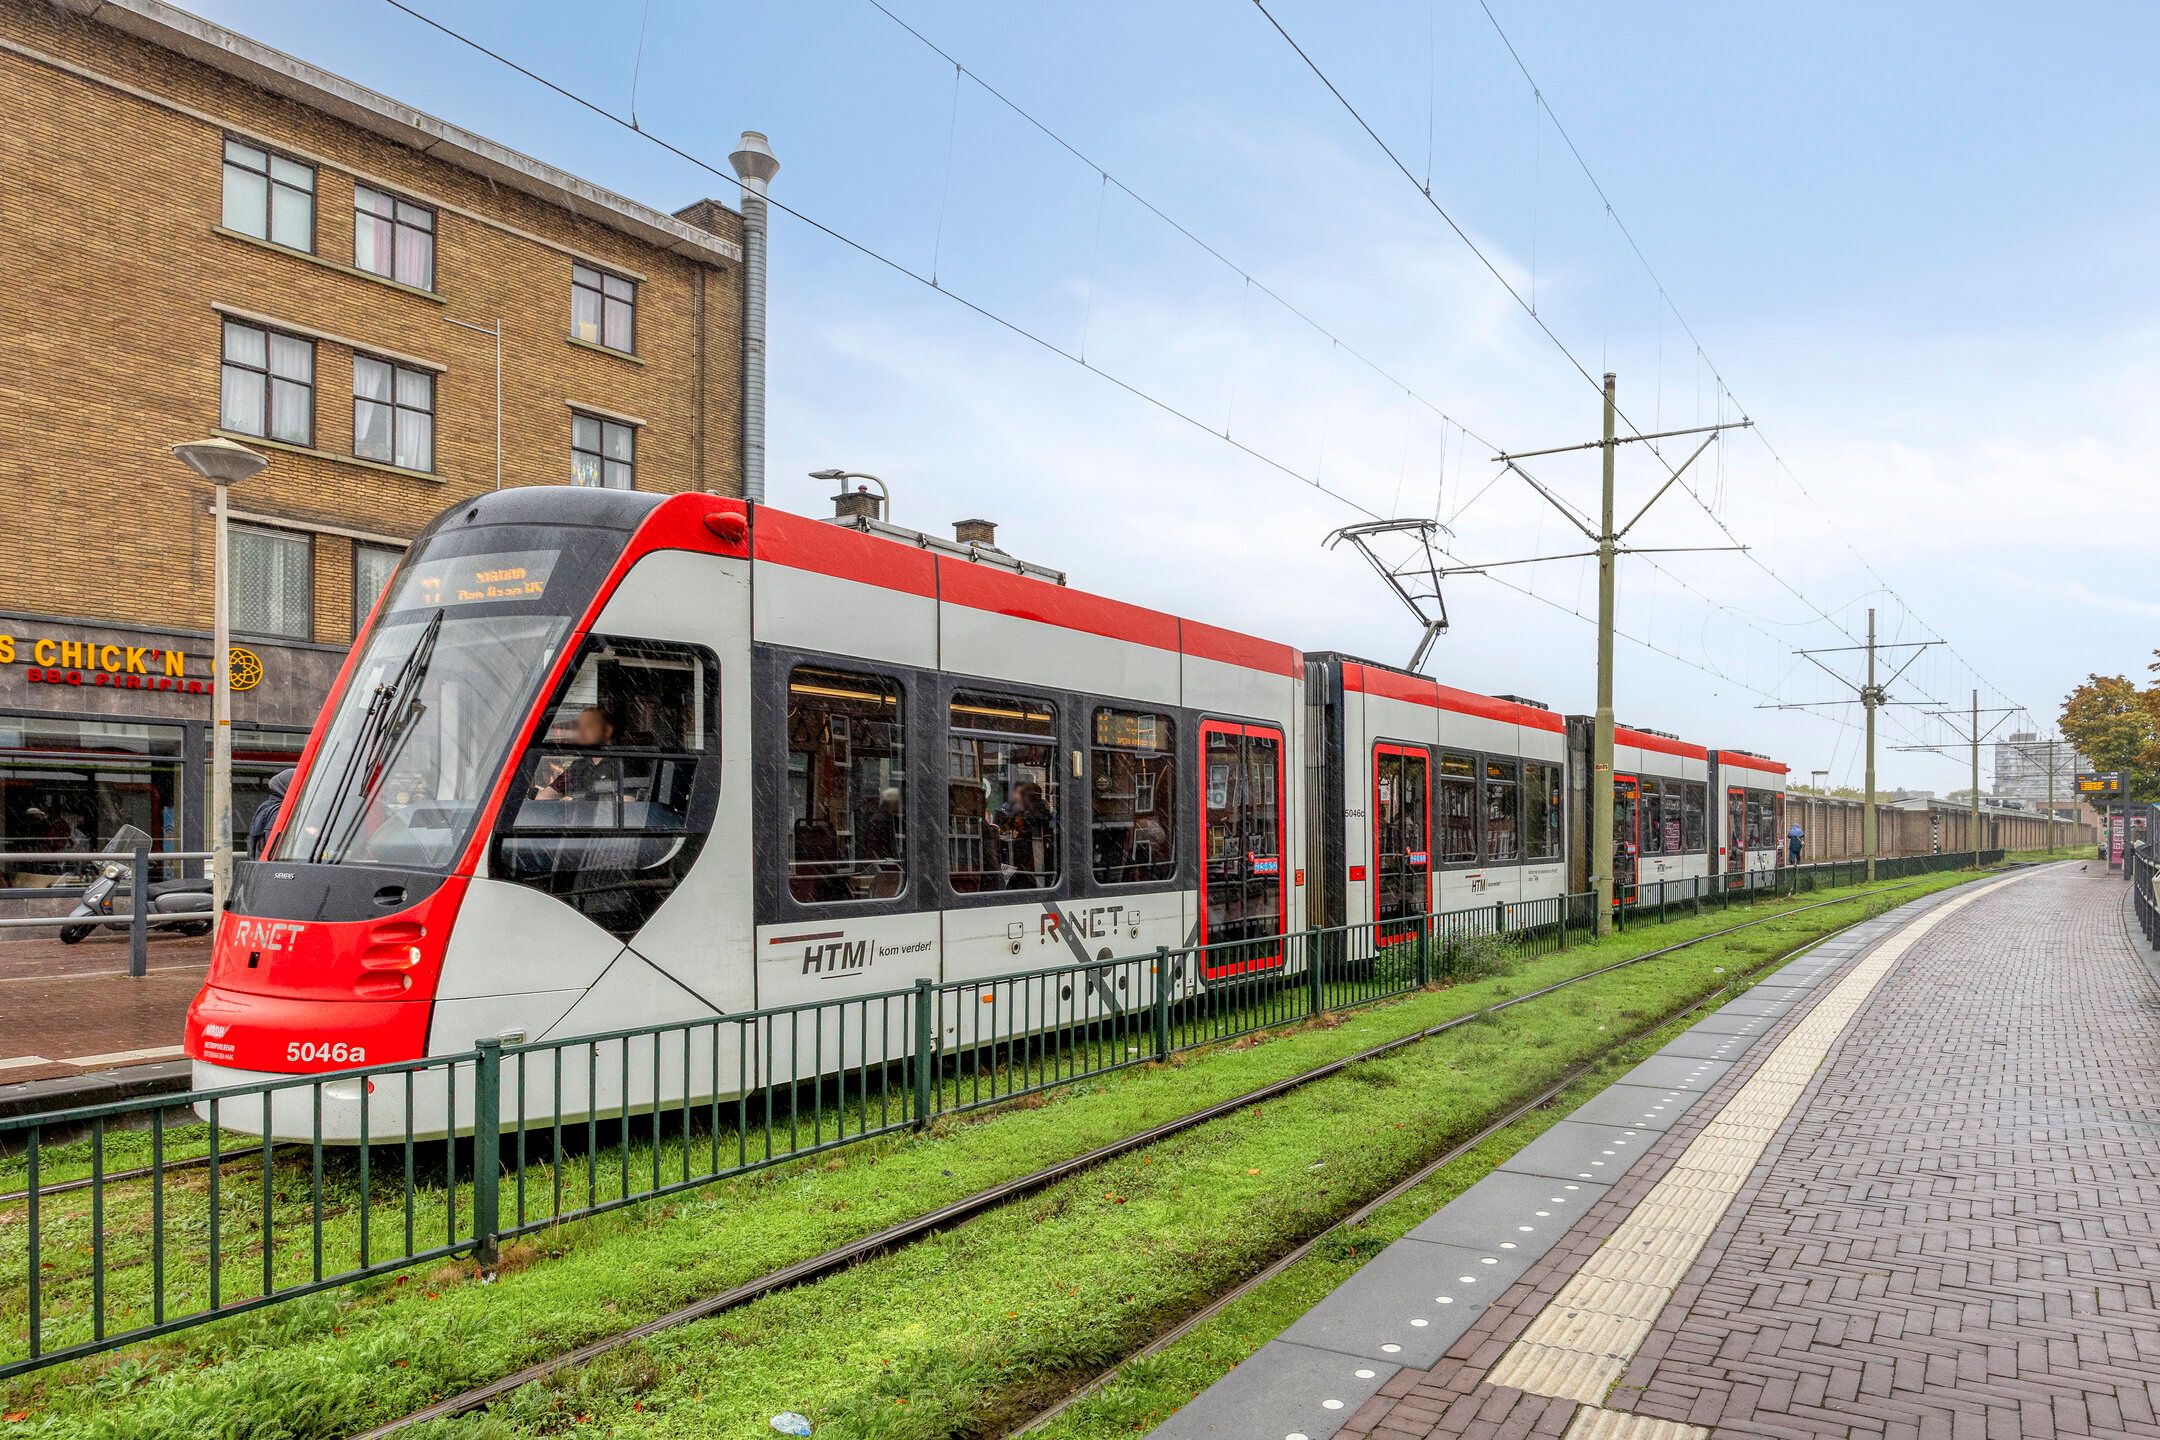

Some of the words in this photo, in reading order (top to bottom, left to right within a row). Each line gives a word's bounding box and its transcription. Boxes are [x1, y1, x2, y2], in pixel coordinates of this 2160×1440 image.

[35, 638, 184, 677] CHICK'N
[28, 668, 81, 687] BBQ
[802, 940, 866, 975] HTM
[879, 947, 899, 957] kom
[901, 941, 932, 954] verder!
[287, 1042, 366, 1062] 5046a
